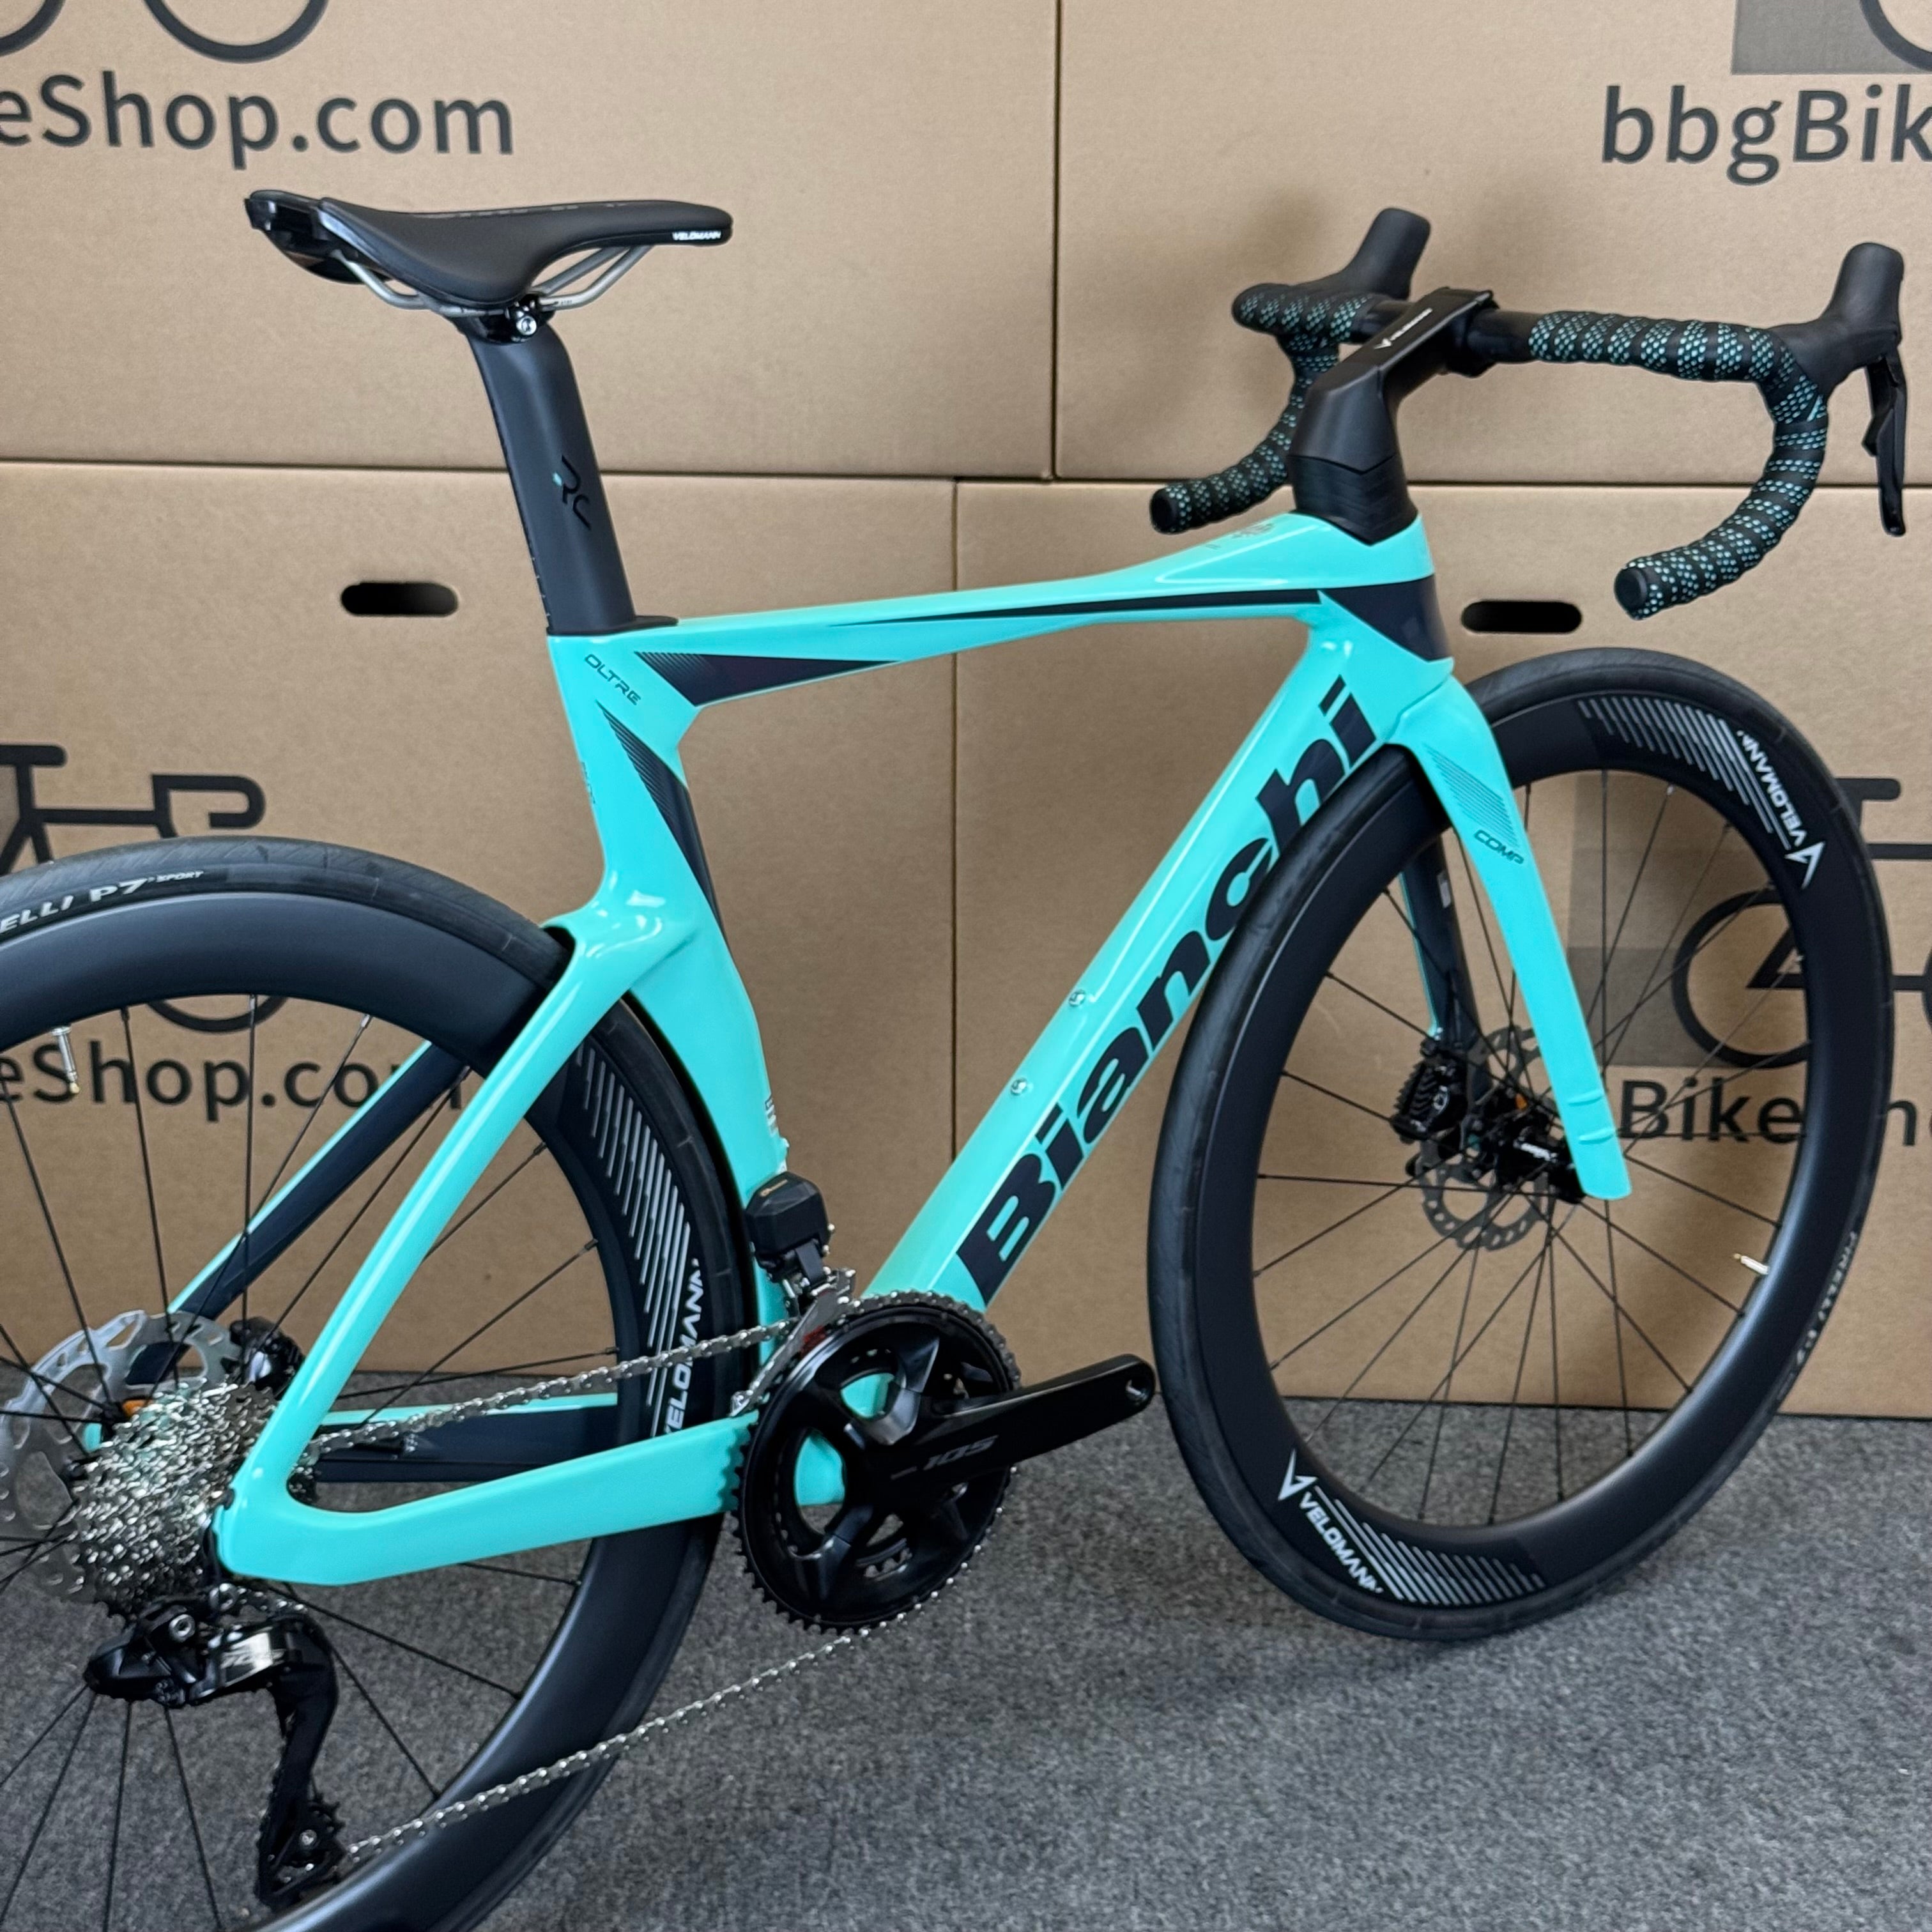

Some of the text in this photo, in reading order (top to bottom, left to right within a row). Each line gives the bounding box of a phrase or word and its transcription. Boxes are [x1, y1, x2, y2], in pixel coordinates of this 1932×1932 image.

[0, 70, 513, 170] eShop.com
[1602, 83, 1932, 186] bbgBik
[585, 654, 641, 706] OLTRE
[1736, 730, 1807, 847] VELOMANN
[89, 877, 148, 902] P7
[1474, 829, 1524, 864] COMP
[956, 674, 1377, 1305] Bianchi
[0, 1040, 463, 1123] eShop.co
[663, 1257, 705, 1436] ELOANN
[1300, 1491, 1384, 1593] VELOMANN
